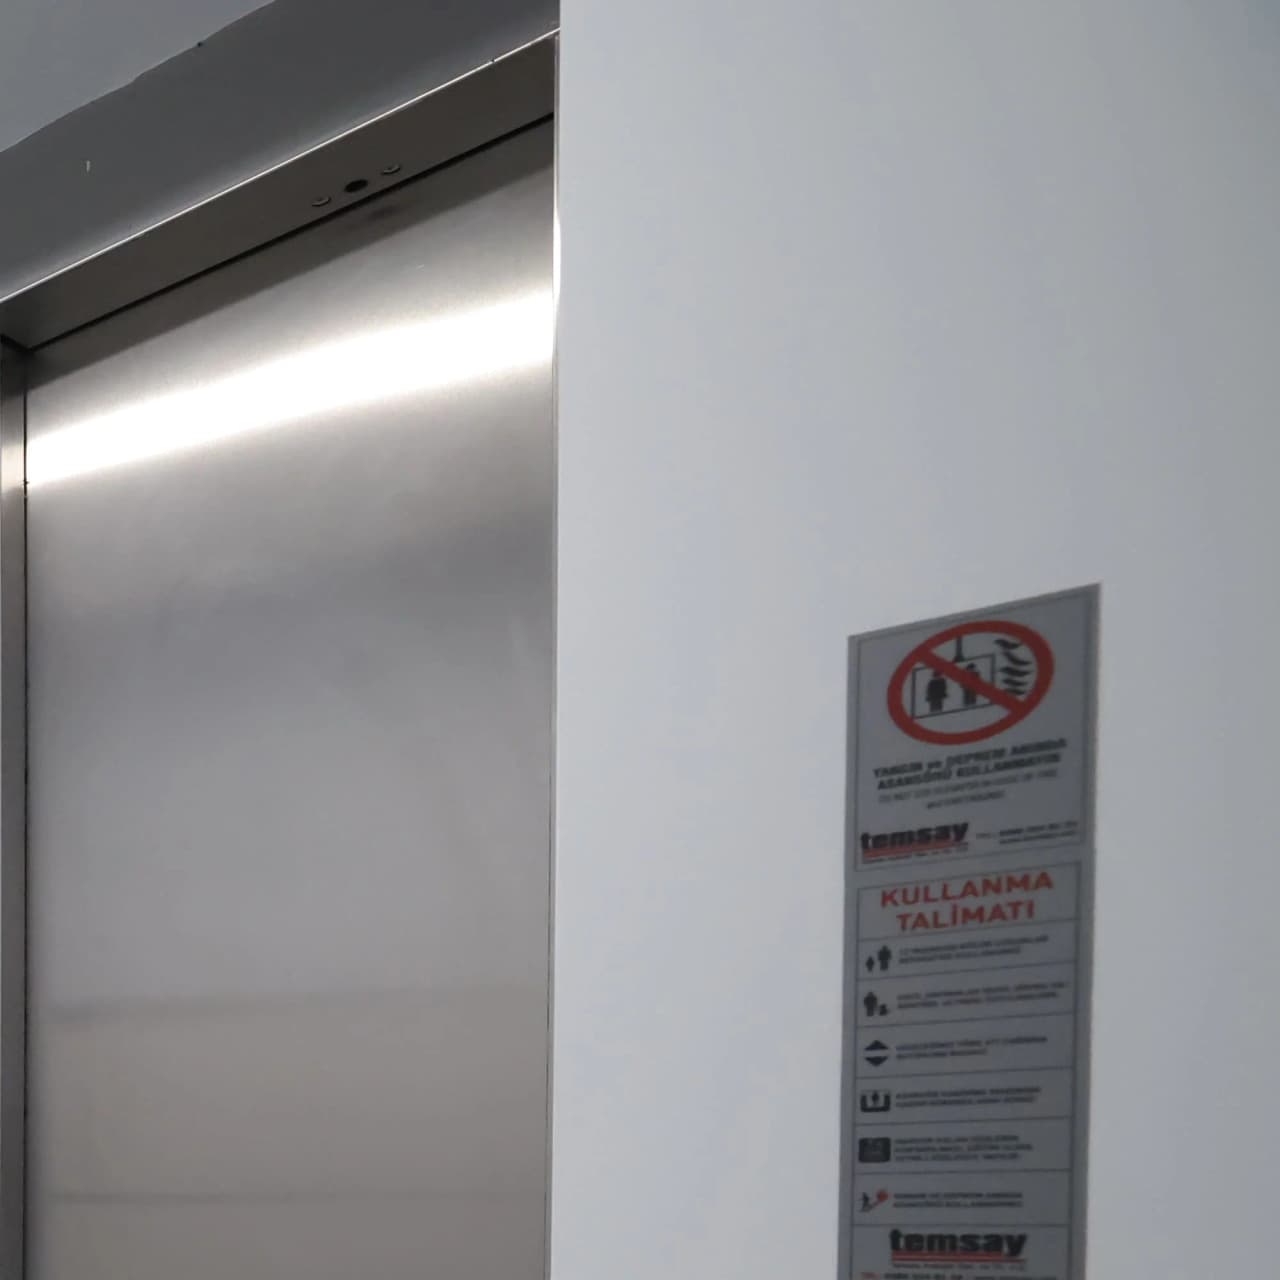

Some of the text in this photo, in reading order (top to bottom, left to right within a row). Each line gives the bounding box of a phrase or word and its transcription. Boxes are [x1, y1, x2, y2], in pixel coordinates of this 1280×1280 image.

[861, 822, 969, 850] temsay
[880, 871, 1054, 908] KULLANMA
[896, 899, 1035, 932] TALİMATI
[890, 1229, 1028, 1258] temsay
